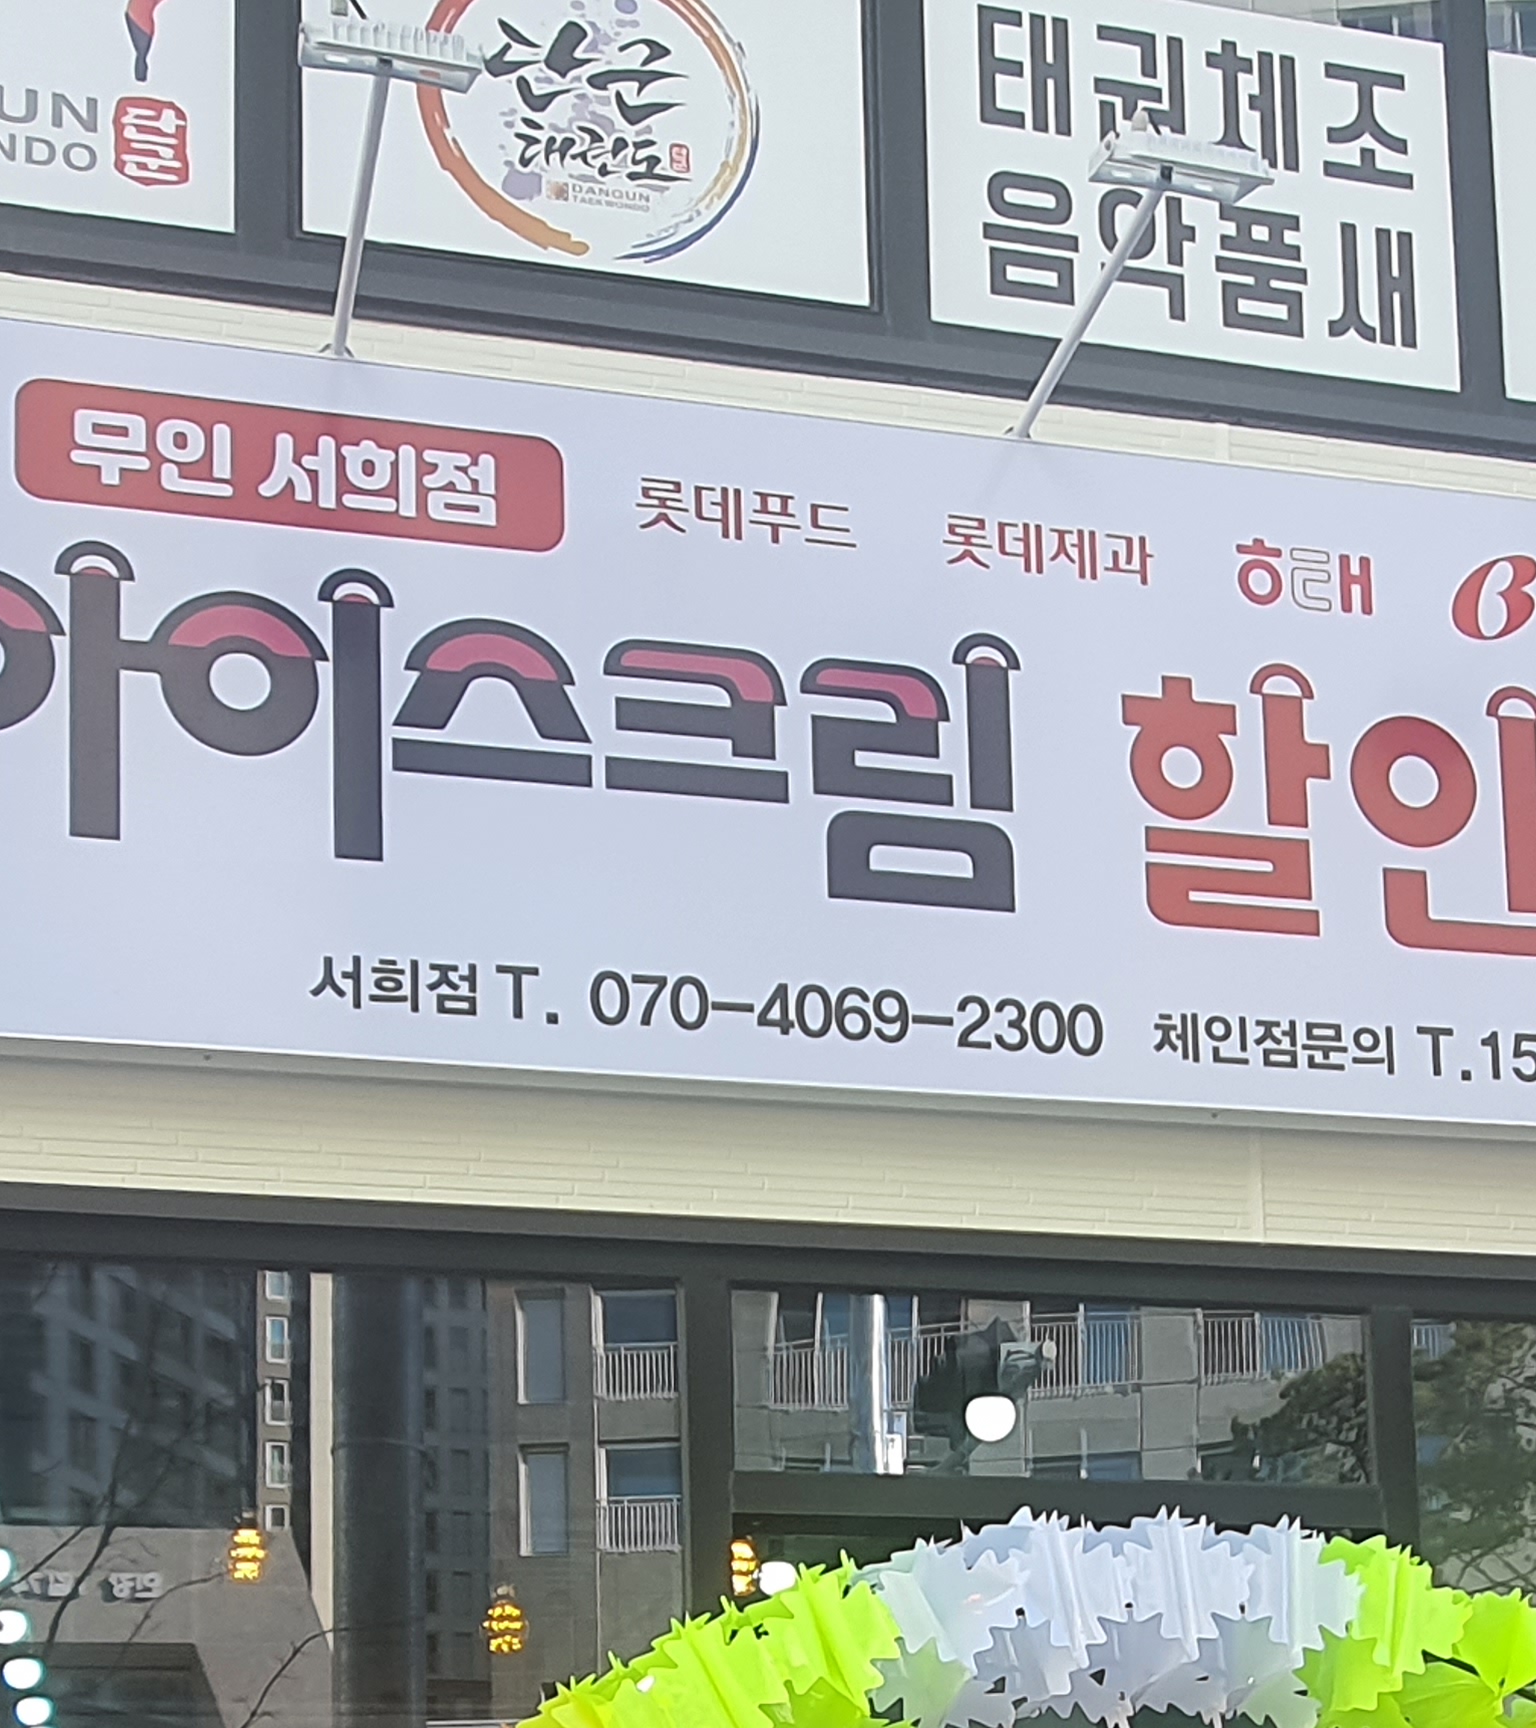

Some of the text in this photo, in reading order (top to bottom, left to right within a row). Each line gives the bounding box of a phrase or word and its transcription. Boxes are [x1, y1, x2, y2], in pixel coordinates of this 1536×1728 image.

[982, 170, 1417, 349] 음악품새
[69, 408, 497, 527] 무인 서희점
[635, 475, 858, 549] 롯데푸드
[942, 511, 1154, 587] 롯데제과
[309, 954, 478, 1017] 서희점
[589, 969, 1104, 1057] 070-4069-2300
[1152, 1010, 1396, 1076] 체인점문의
